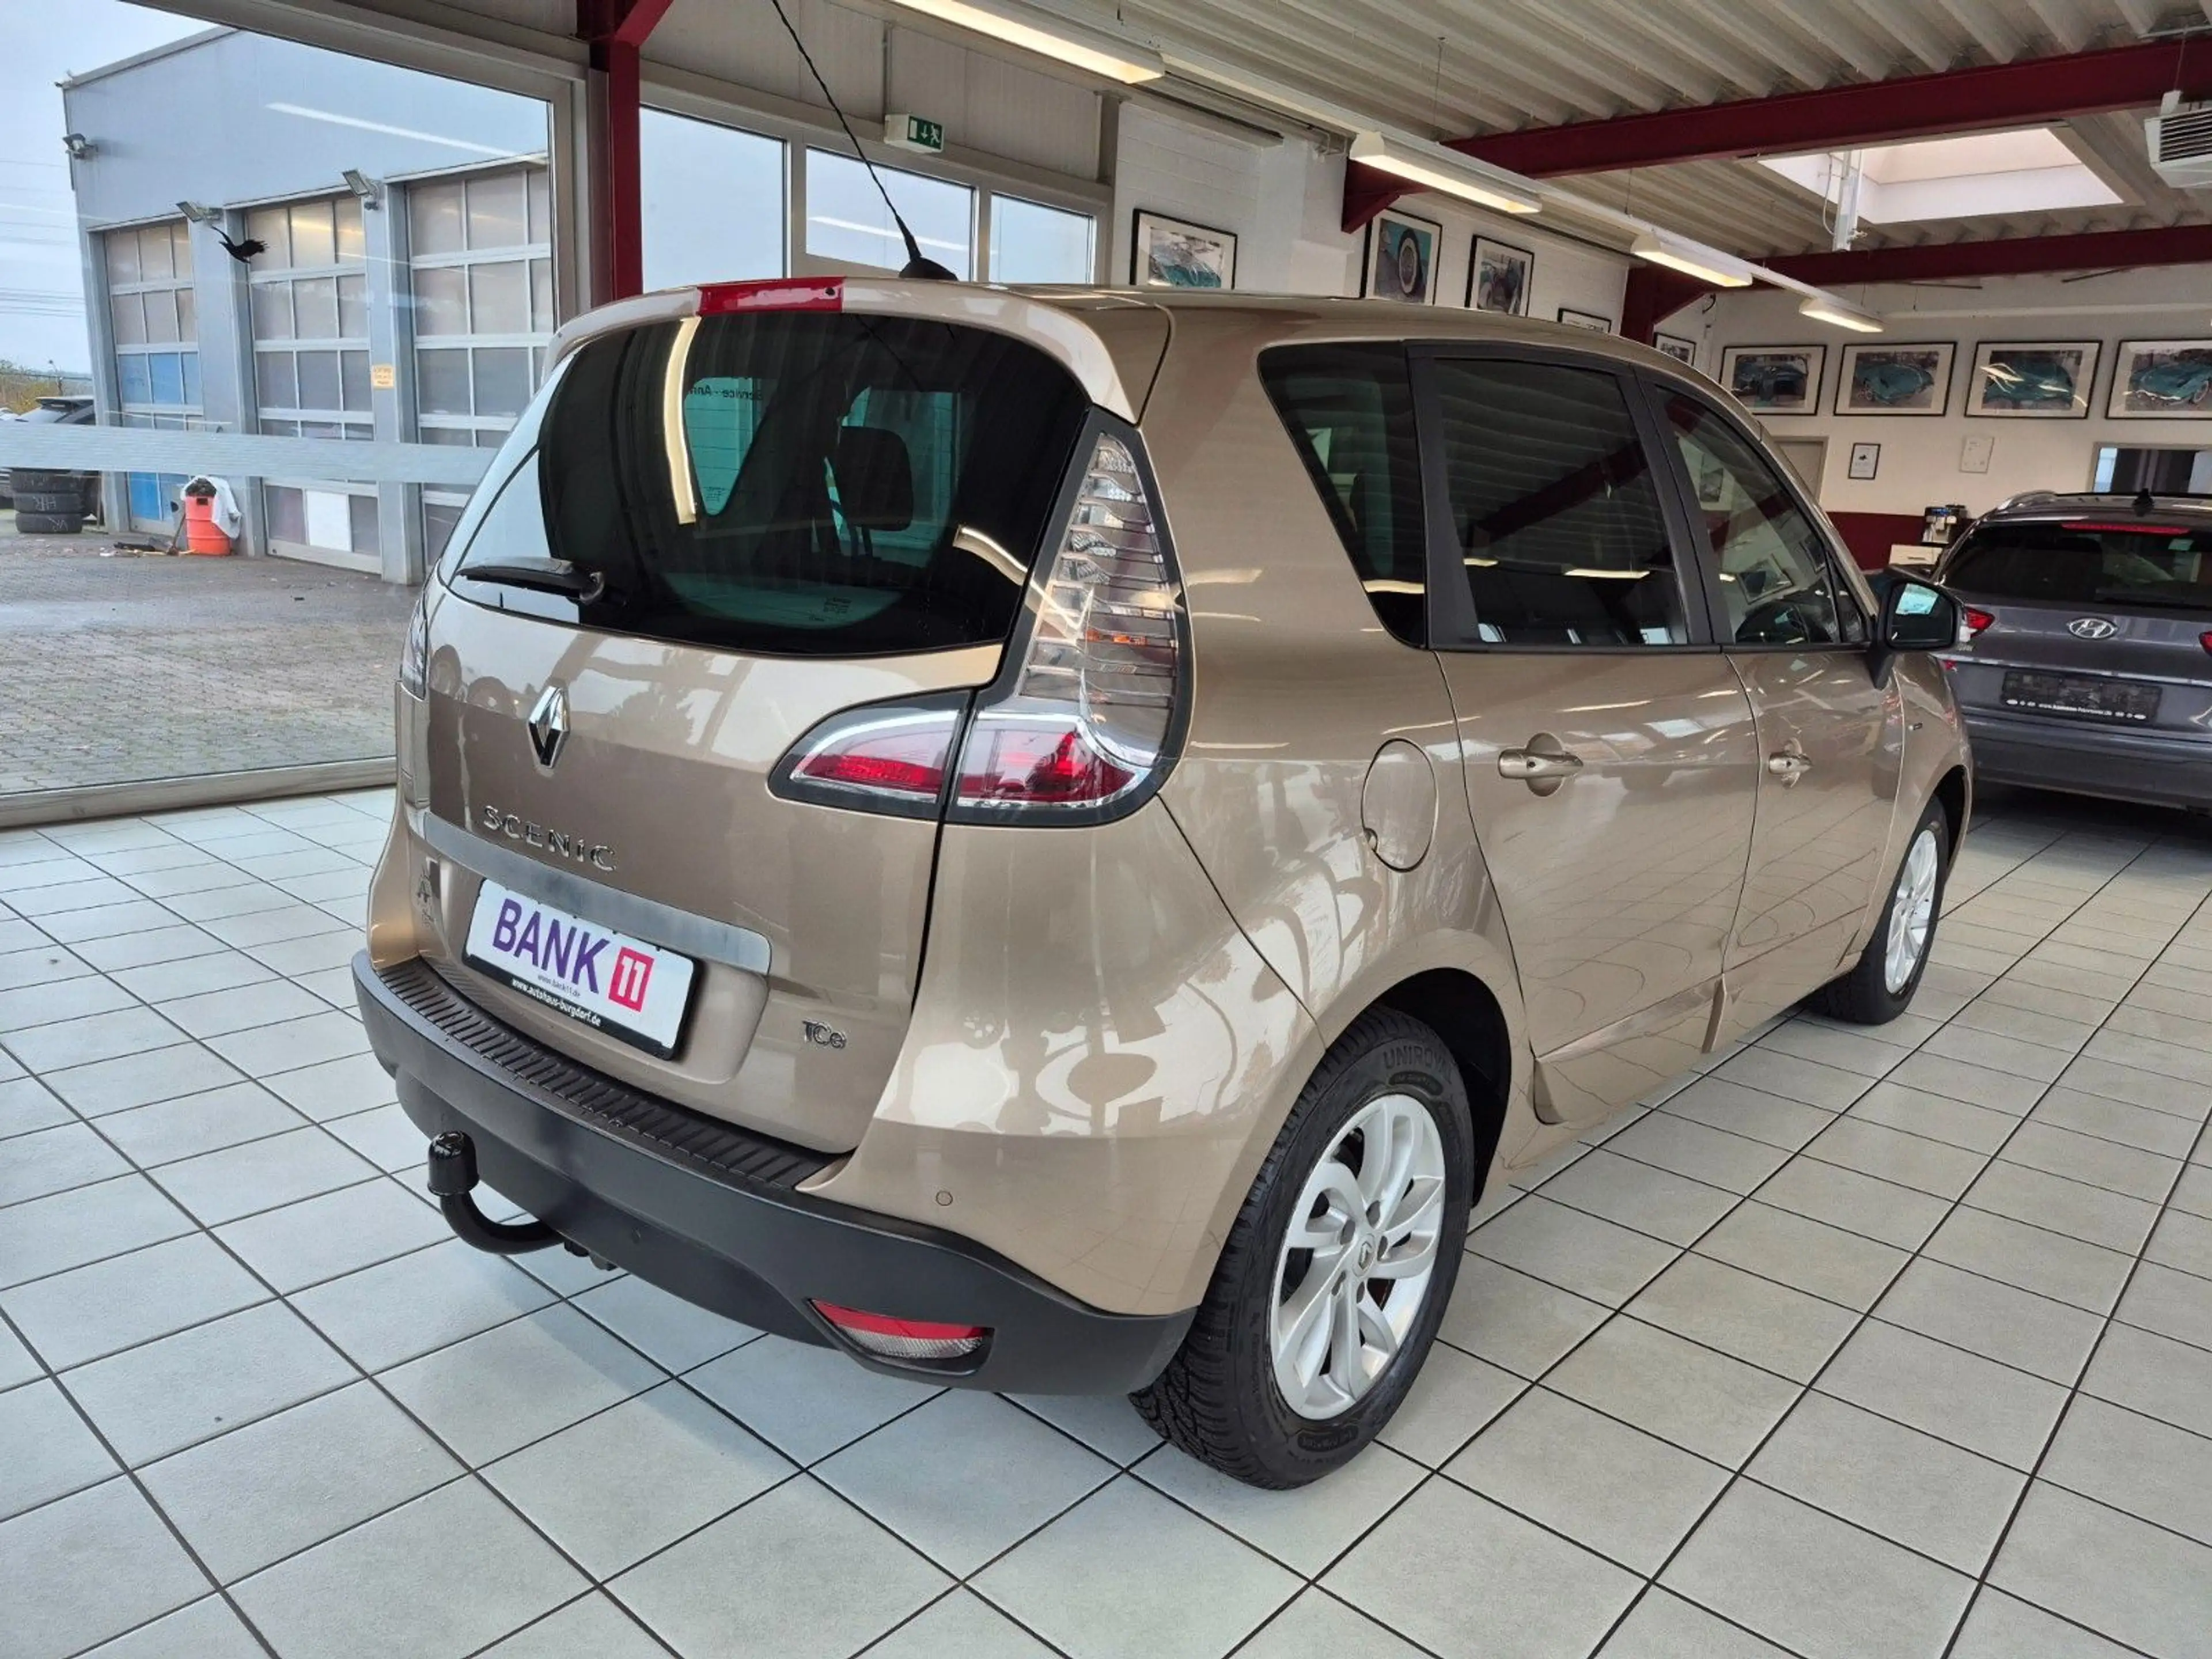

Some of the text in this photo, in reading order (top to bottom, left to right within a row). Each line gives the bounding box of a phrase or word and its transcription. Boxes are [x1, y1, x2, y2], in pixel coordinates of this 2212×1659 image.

[484, 805, 616, 872] SCENIC
[493, 898, 647, 1003] BANK 11
[512, 978, 601, 1027] www.autohaus-burgdorf.de
